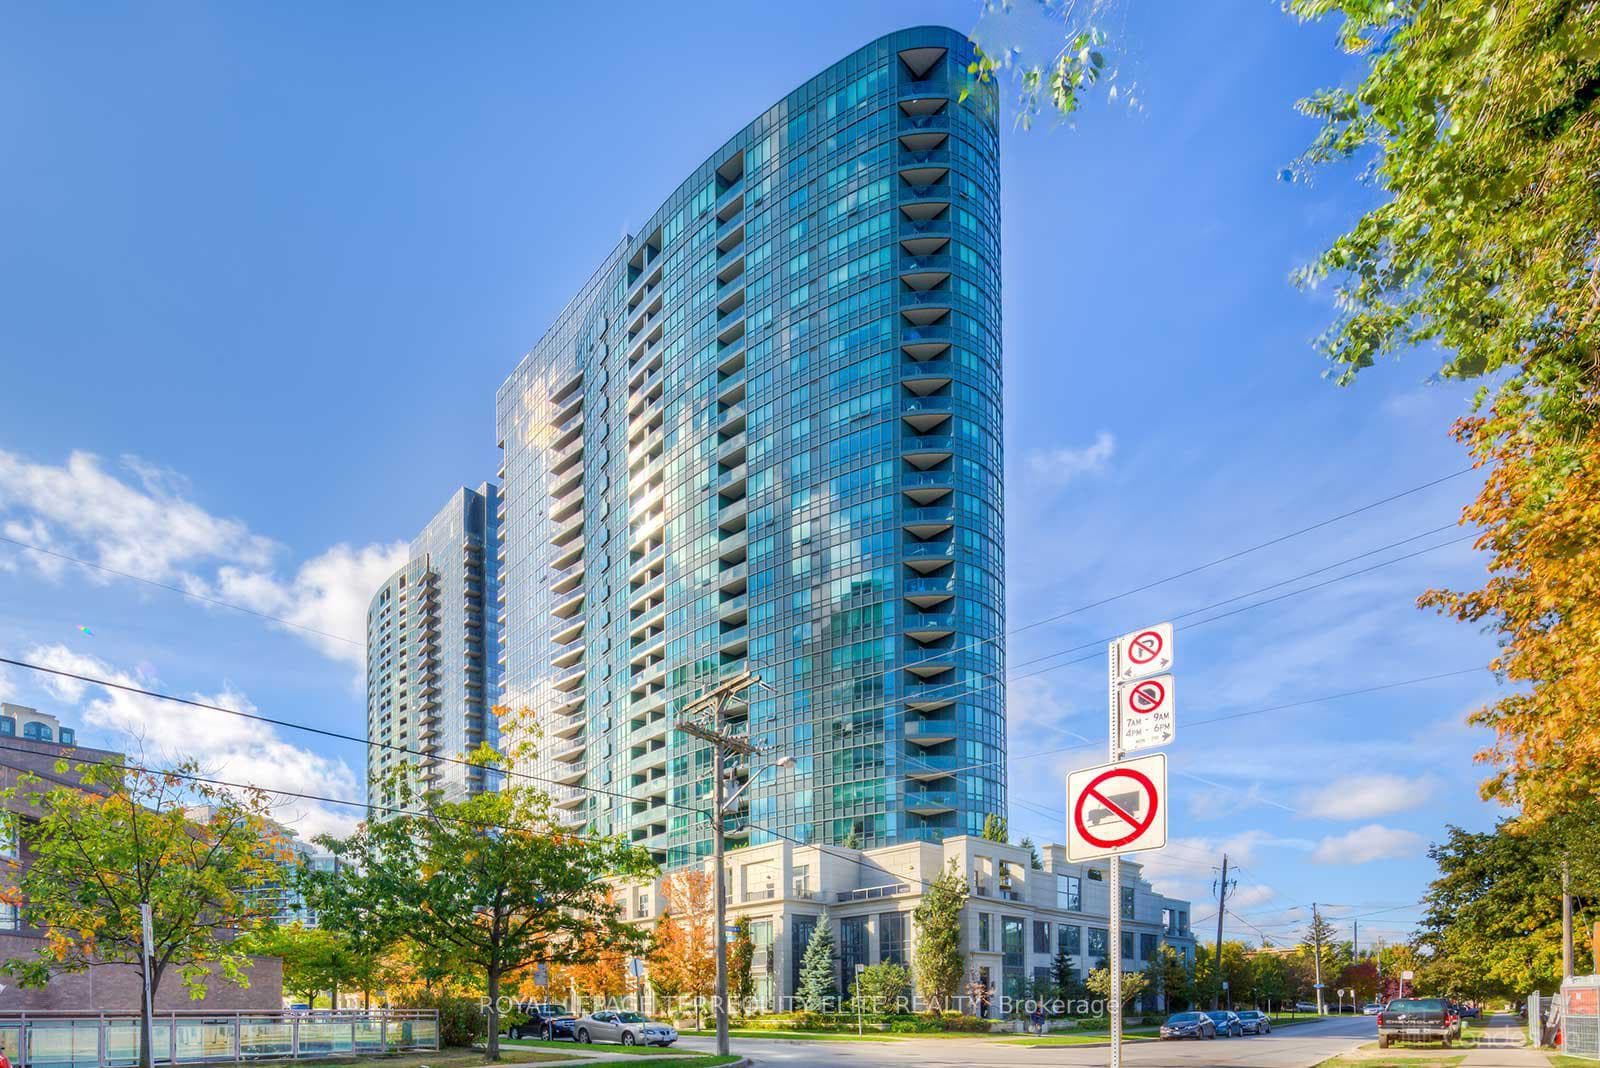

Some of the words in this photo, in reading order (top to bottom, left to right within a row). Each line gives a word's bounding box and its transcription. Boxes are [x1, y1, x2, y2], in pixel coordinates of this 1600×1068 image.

[1126, 718, 1142, 728] 7AM
[1153, 711, 1170, 722] 9AM
[1125, 728, 1142, 737] 4PM
[1153, 722, 1171, 733] 6PM
